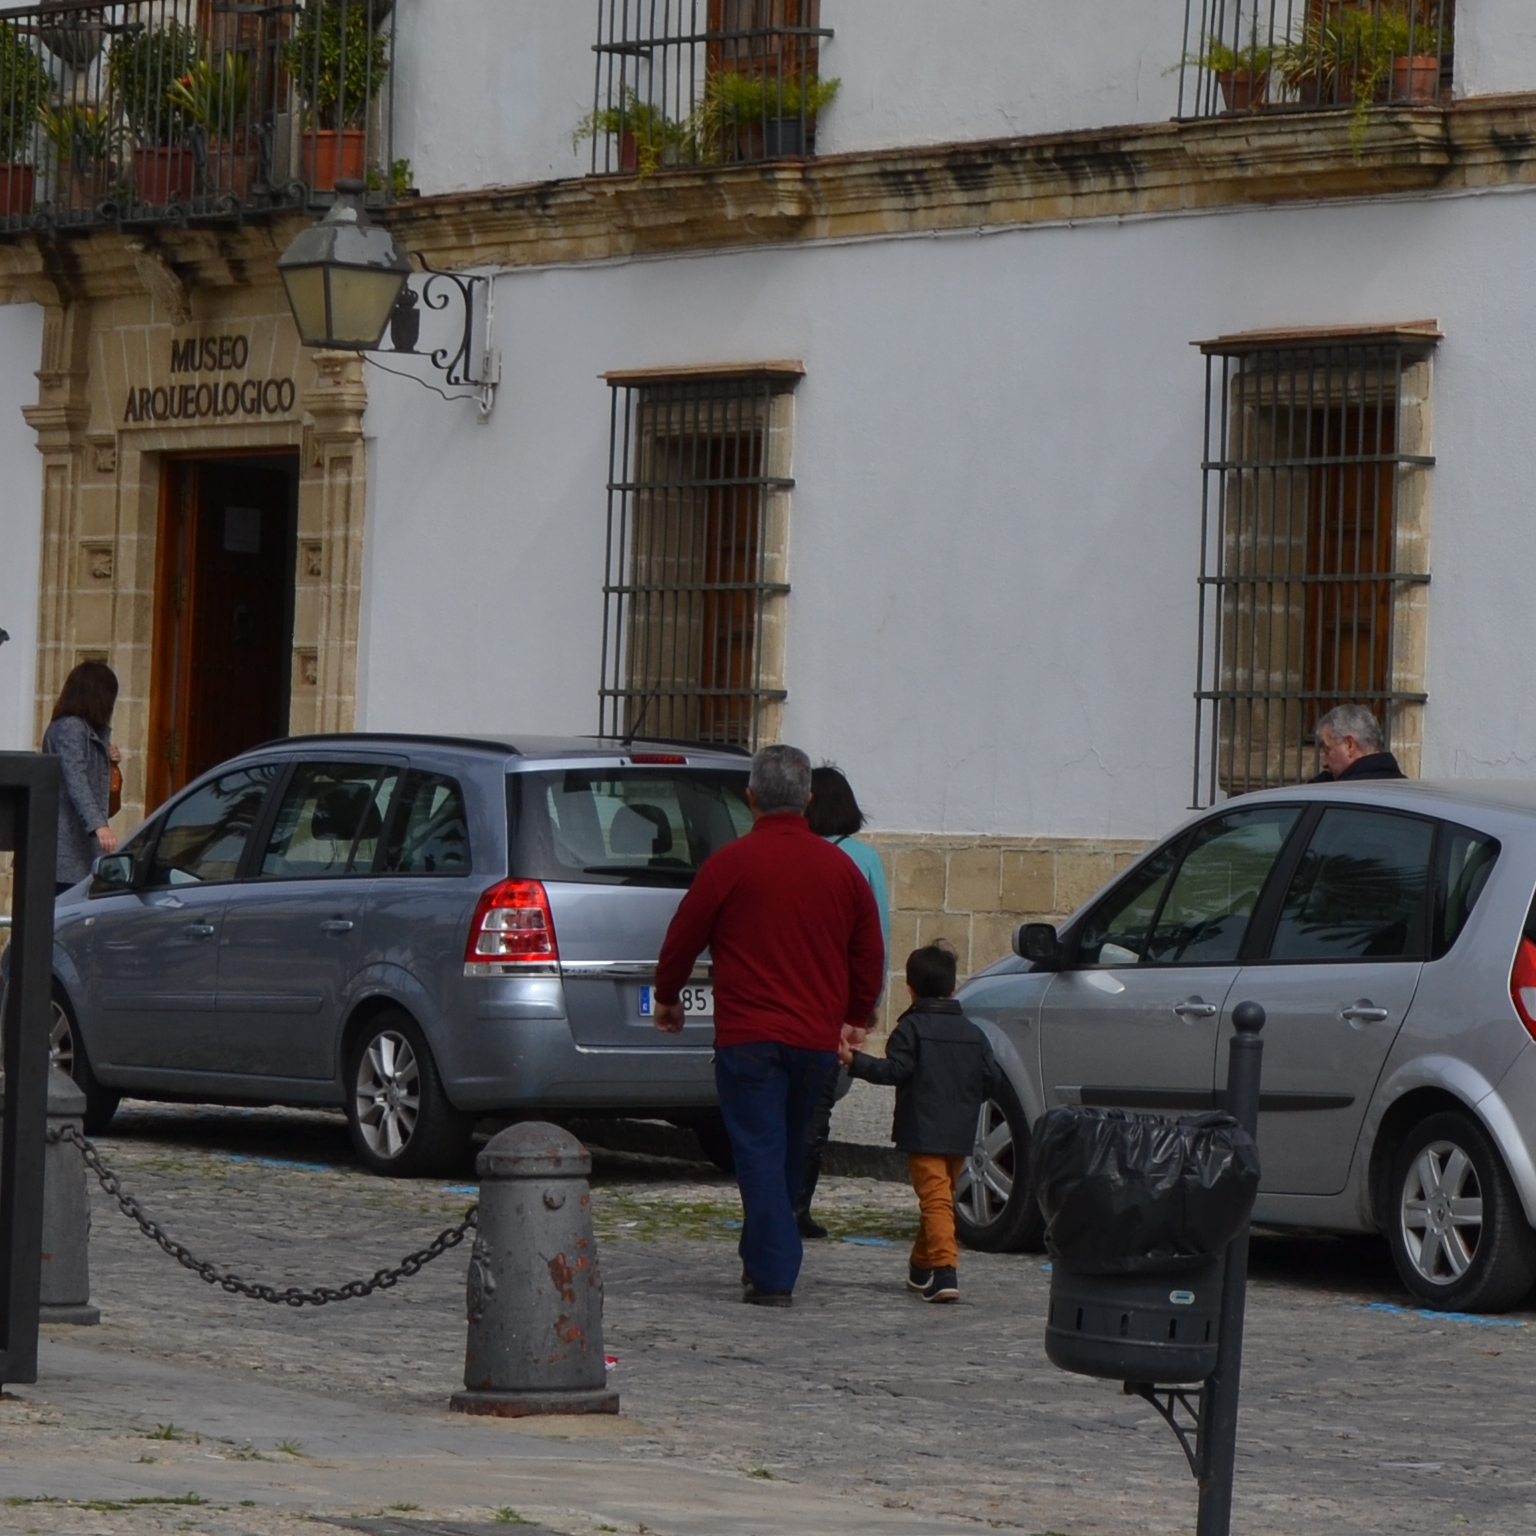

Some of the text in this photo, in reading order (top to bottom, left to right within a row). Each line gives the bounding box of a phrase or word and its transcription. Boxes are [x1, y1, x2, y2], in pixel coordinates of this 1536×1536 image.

[170, 334, 249, 373] MUSEO
[123, 377, 296, 423] ARQUEOLOGICO
[681, 989, 707, 1011] 85
